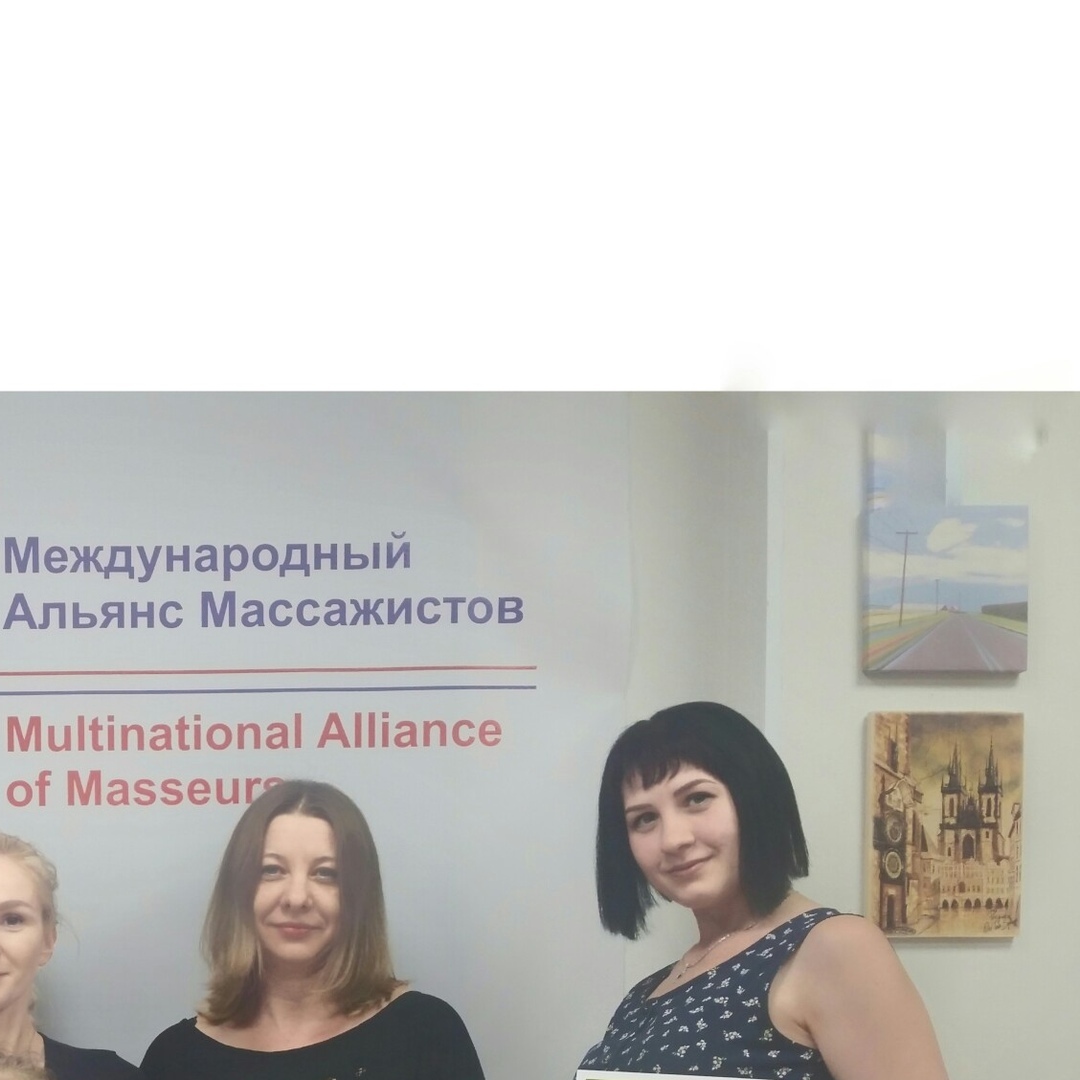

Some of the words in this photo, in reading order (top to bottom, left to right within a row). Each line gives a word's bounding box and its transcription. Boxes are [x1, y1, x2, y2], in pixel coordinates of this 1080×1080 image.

[3, 530, 411, 582] Международный
[3, 593, 183, 630] Альянс
[200, 591, 524, 628] Массажистов
[6, 713, 303, 752] Multinational
[317, 711, 502, 749] Alliance
[6, 770, 51, 807] of
